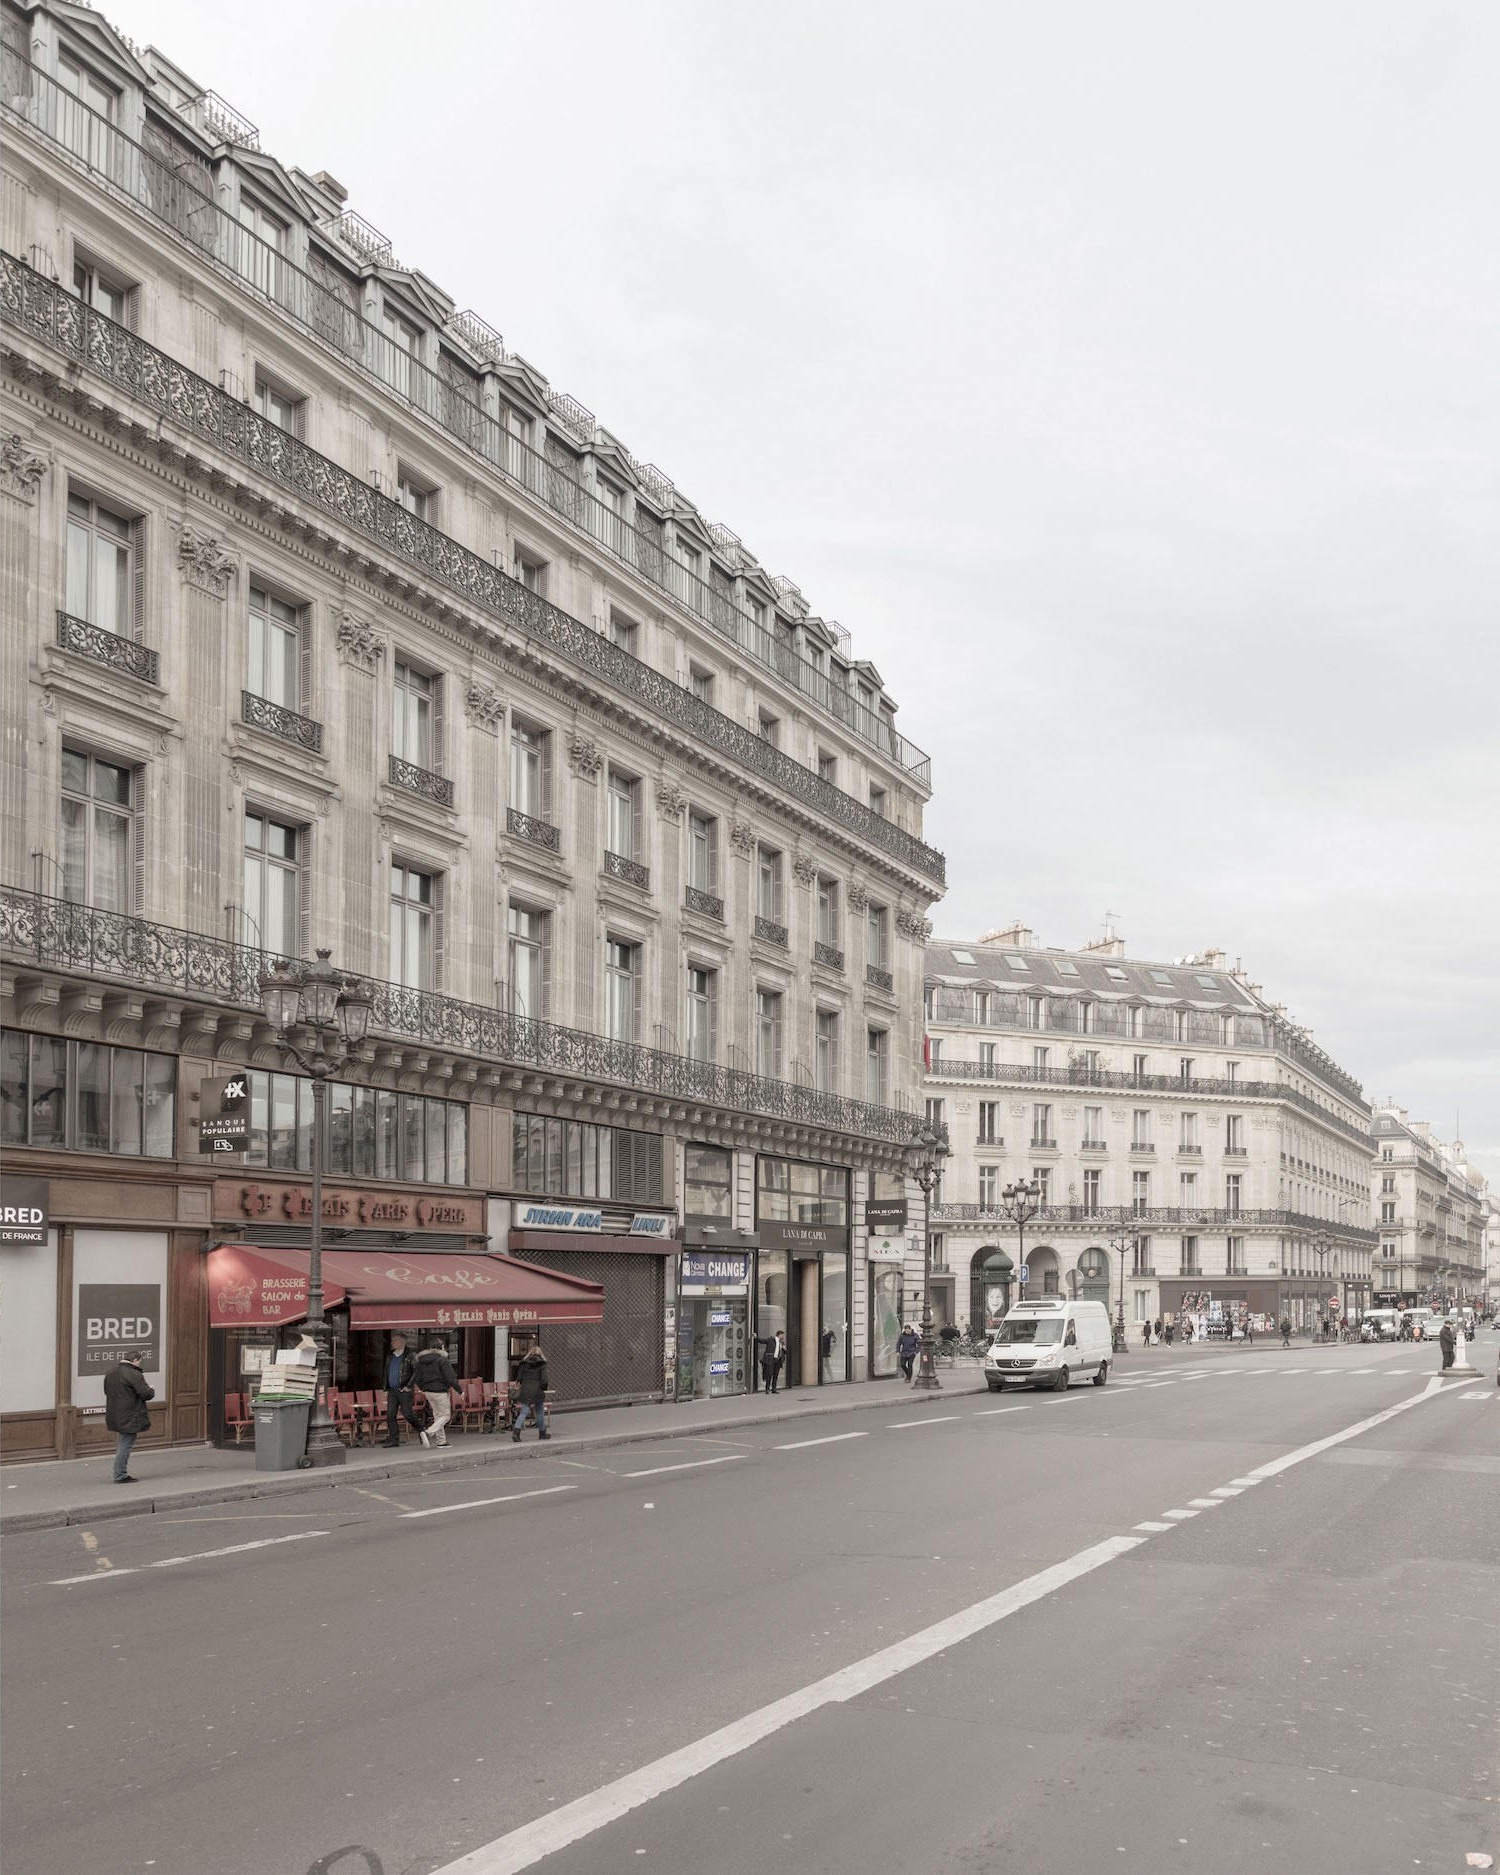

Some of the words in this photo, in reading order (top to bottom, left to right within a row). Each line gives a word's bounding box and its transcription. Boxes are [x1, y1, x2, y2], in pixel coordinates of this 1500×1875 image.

[202, 1119, 246, 1127] BANQUE
[202, 1126, 246, 1135] POPULAIRE
[0, 1206, 44, 1224] RED
[523, 1207, 574, 1226] SYRIAN
[631, 1216, 666, 1233] LINES
[2, 1232, 13, 1240] DE
[13, 1232, 43, 1241] FRANCE
[782, 1229, 800, 1239] LANA
[801, 1230, 807, 1239] DI
[808, 1231, 827, 1241] CAPRA
[708, 1261, 745, 1276] CHANGE
[262, 1278, 306, 1289] BRASSERIE
[363, 1266, 499, 1290] Café
[261, 1291, 291, 1302] SALON
[294, 1291, 305, 1300] de
[262, 1305, 281, 1315] BAR
[711, 1314, 731, 1323] CHANGE
[86, 1317, 153, 1340] BRED
[86, 1352, 101, 1362] ILE
[102, 1352, 115, 1361] DE
[116, 1350, 153, 1360] FRCE
[710, 1364, 729, 1373] CHANGE
